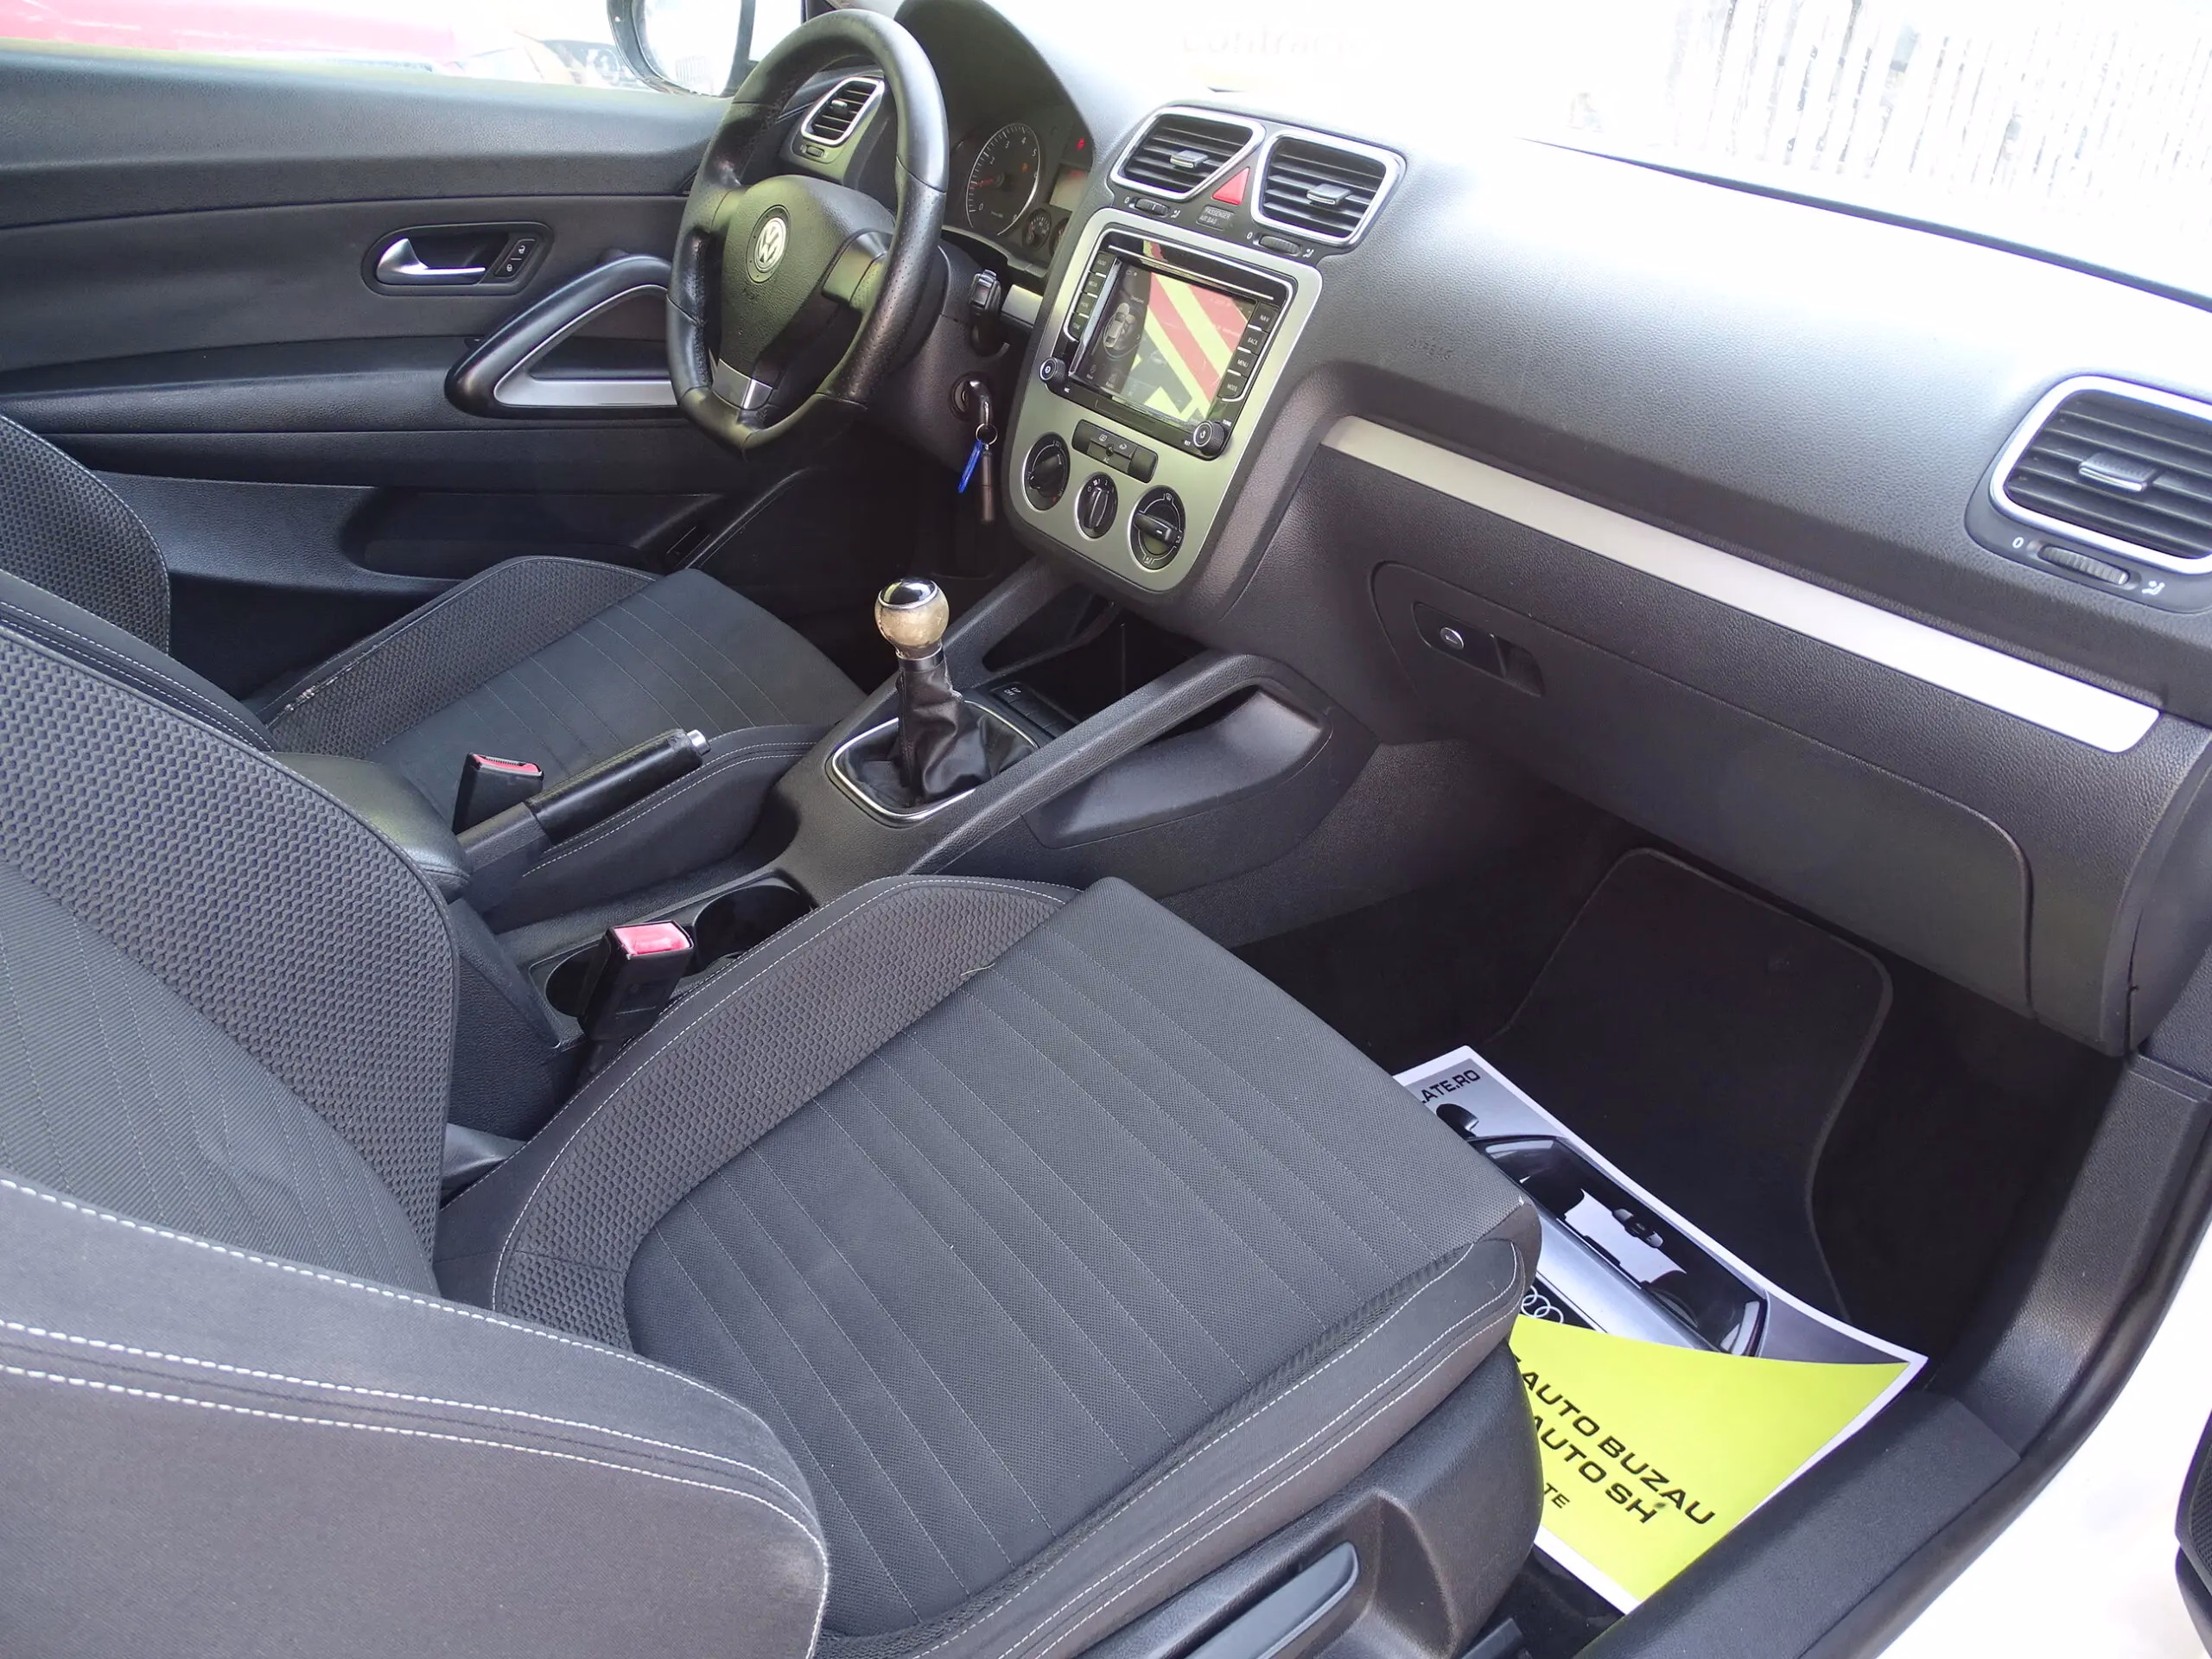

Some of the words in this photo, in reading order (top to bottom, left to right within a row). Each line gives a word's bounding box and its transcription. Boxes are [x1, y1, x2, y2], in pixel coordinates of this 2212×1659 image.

[1247, 337, 1258, 346] BACK
[1237, 359, 1249, 368] MENU
[1226, 382, 1238, 391] MODE
[2012, 537, 2024, 549] 0
[1421, 1069, 1481, 1103] ATE.RO
[1522, 1371, 1600, 1436] AUTO
[1598, 1435, 1716, 1524] BUZAU
[1605, 1482, 1657, 1523] SH
